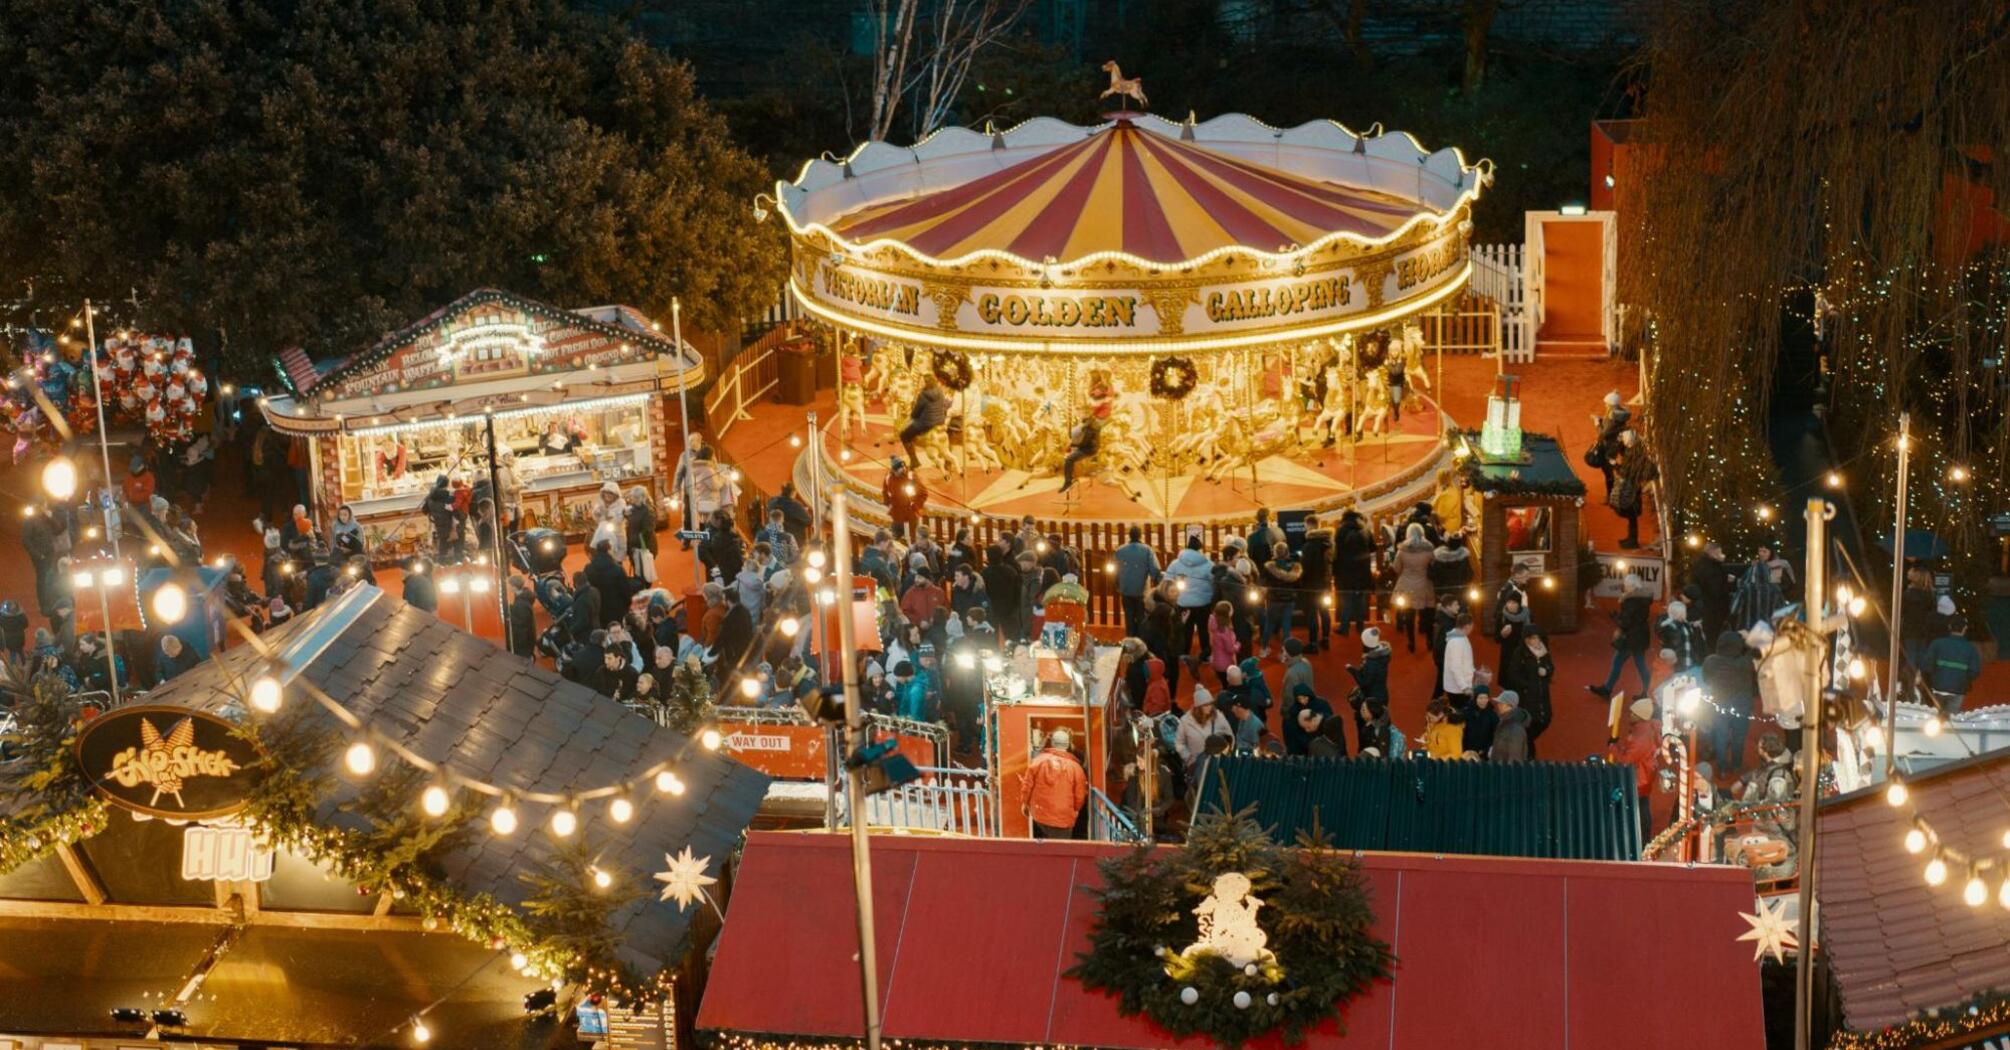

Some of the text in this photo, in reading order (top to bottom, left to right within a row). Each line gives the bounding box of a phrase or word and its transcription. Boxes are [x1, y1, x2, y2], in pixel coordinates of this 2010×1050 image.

[822, 264, 919, 316] VICTORIAN
[978, 293, 1136, 328] GOLDEN
[1206, 275, 1351, 322] GALLOPING
[732, 736, 783, 748] WAY OUT
